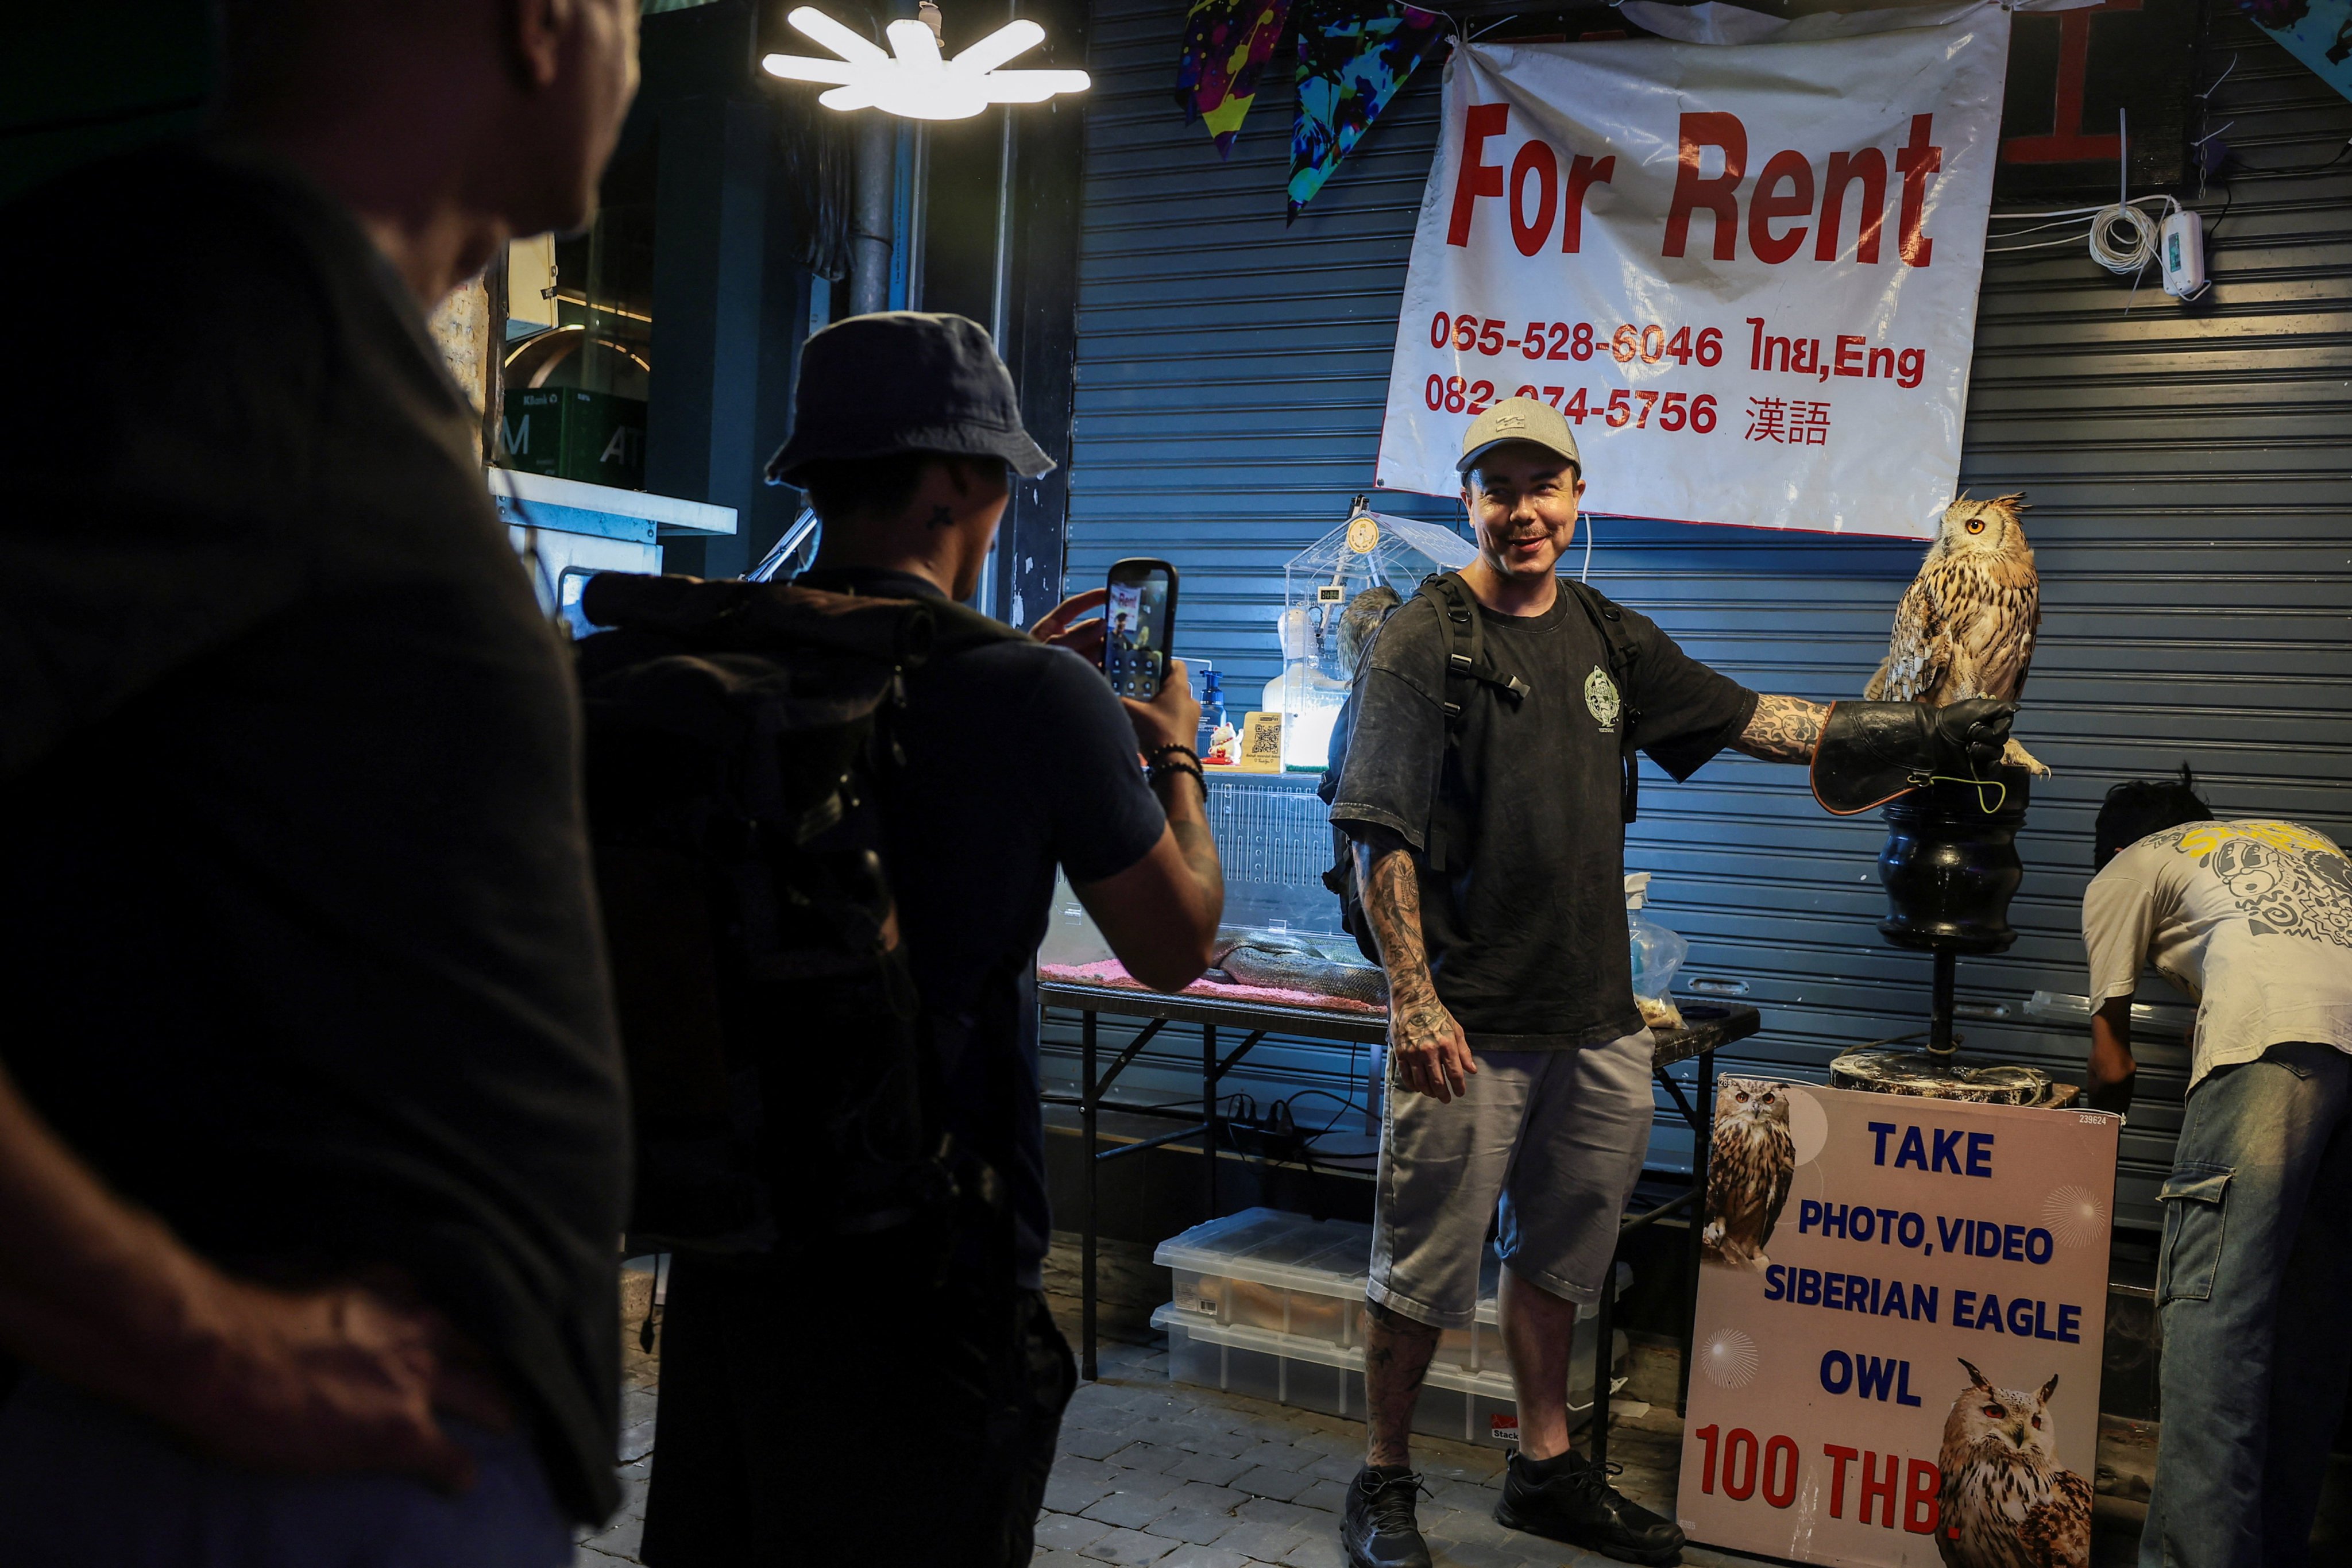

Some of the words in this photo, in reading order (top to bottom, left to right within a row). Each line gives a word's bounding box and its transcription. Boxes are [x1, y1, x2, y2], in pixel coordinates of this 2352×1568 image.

[1447, 103, 1615, 257] For
[1662, 111, 1941, 267] Rent
[1430, 311, 1723, 367] 065-528-6046
[1744, 396, 1831, 446] 漢語
[2079, 1115, 2106, 1125] 239624
[1868, 1122, 1994, 1177] TAKE
[1798, 1199, 2053, 1265] PHOTO,VIDEO
[1764, 1265, 1938, 1323] SIBERIAN
[1953, 1290, 2081, 1343] EAGLE
[1821, 1350, 1921, 1407] OWL
[1494, 1430, 1519, 1440] Stack
[1696, 1423, 1799, 1509] 100
[1823, 1443, 1961, 1540] THB.
